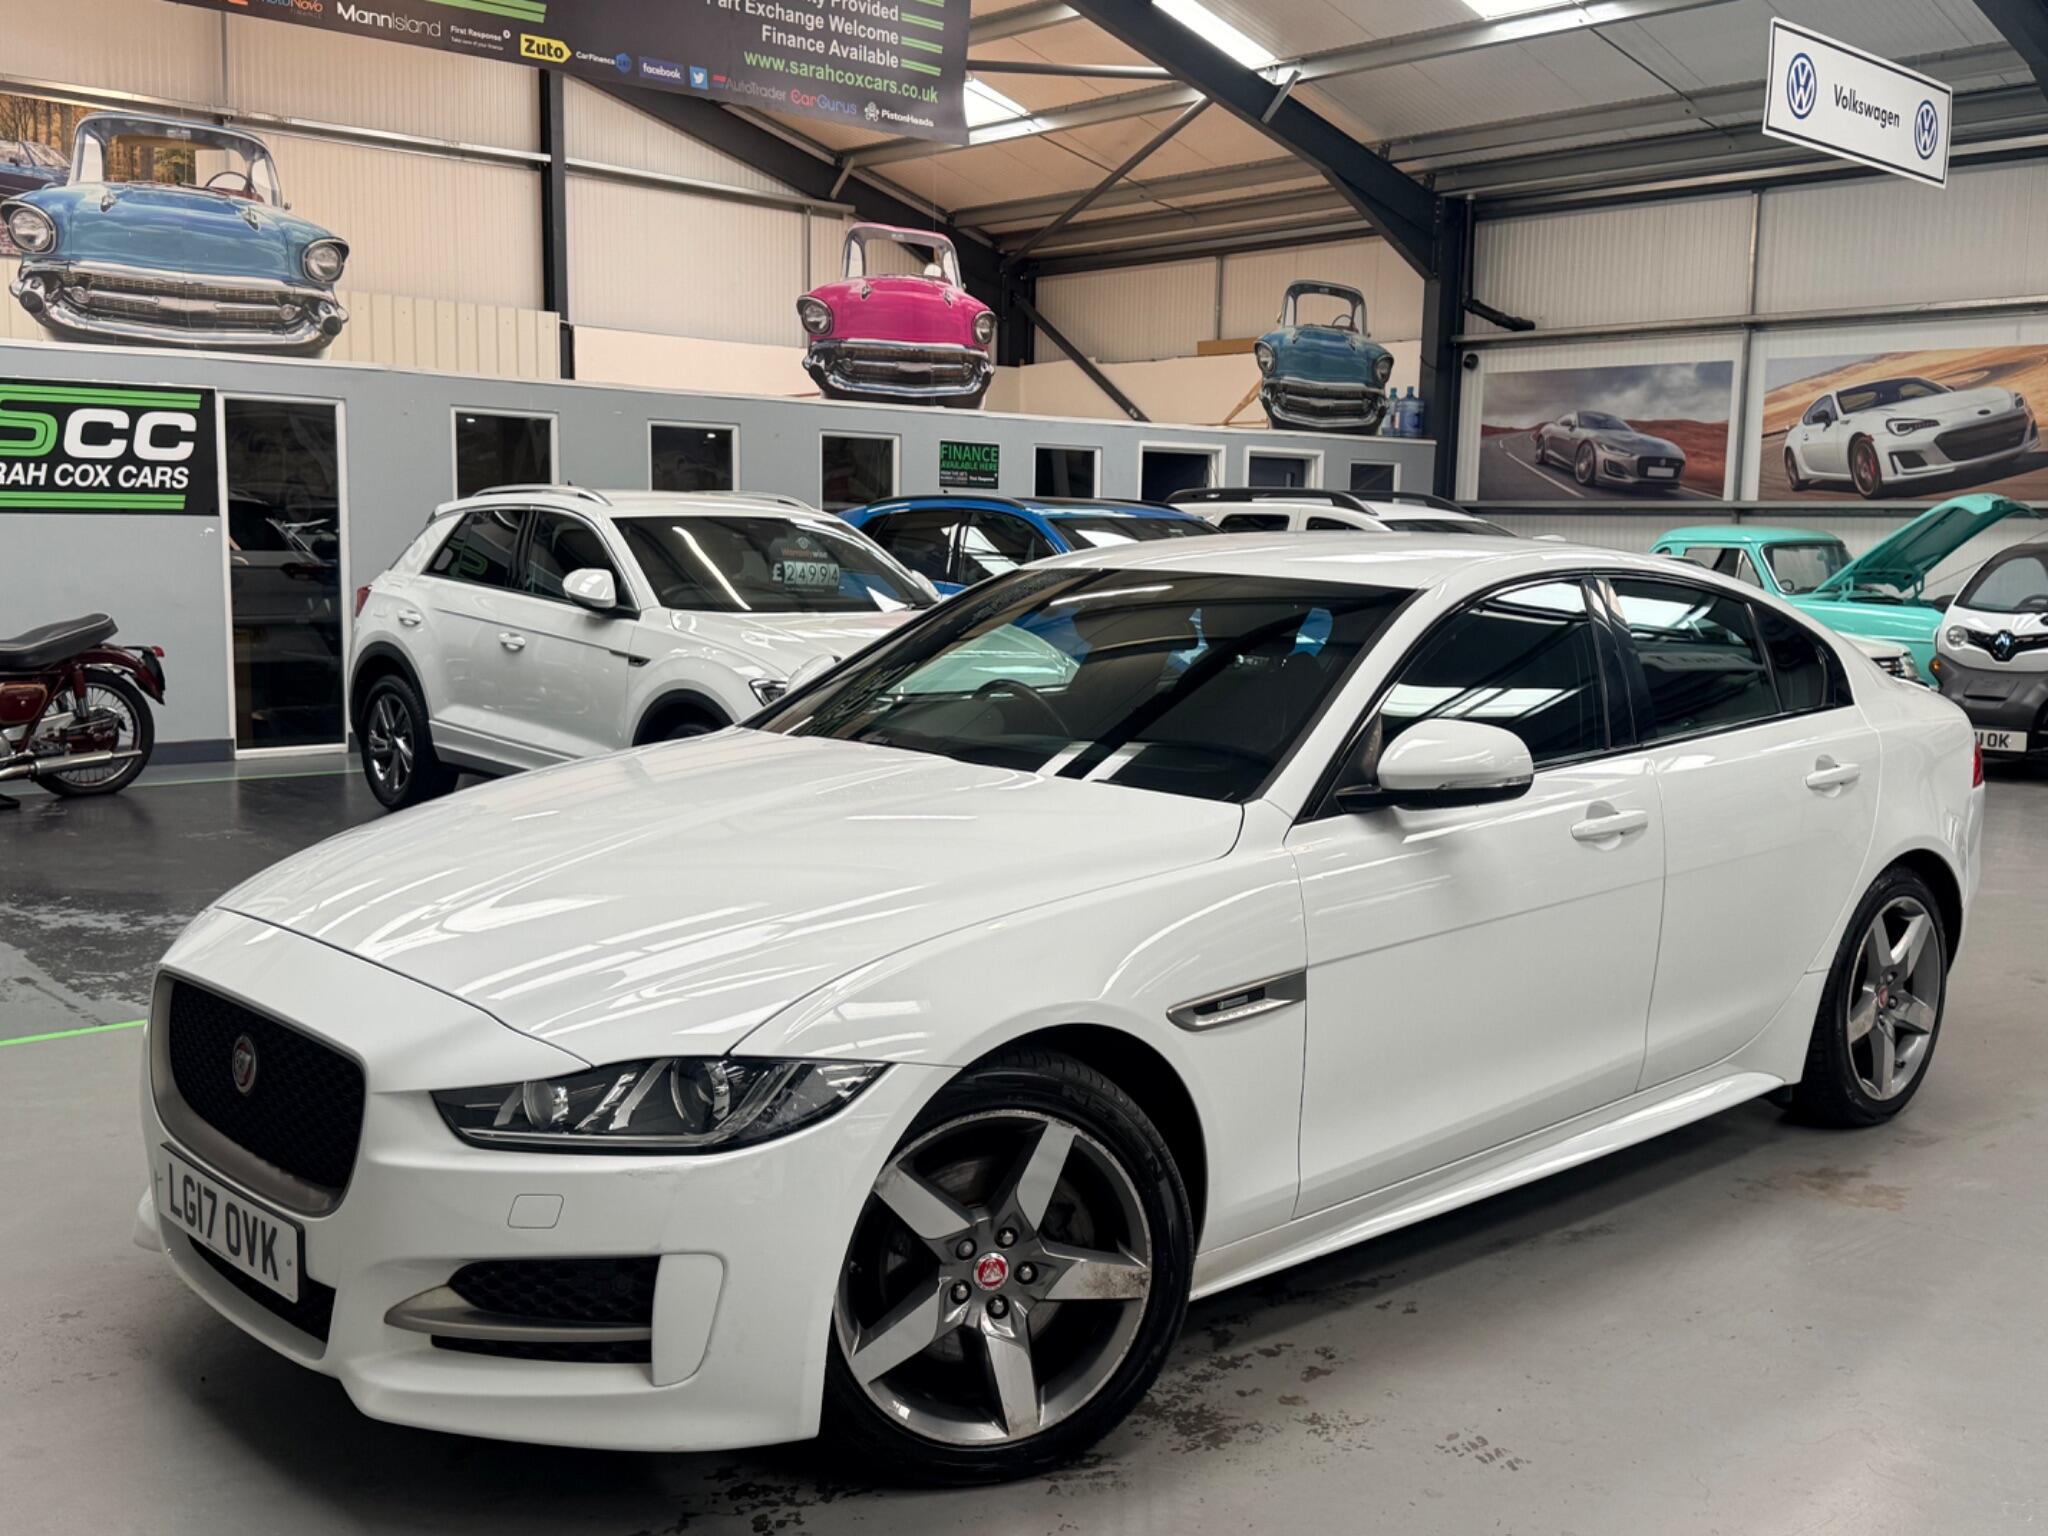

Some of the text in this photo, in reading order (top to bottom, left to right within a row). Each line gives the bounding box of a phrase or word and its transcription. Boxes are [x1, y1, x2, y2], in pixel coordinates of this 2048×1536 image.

[745, 0, 825, 31] Exchange
[828, 14, 899, 45] Welcome
[524, 38, 565, 59] Zuto
[761, 24, 899, 69] Finance Available
[642, 62, 682, 79] facebook
[743, 51, 939, 104] www.sarahcoxcars.co.uk
[791, 88, 857, 115] CarGurus
[1834, 84, 1901, 129] Volkswagen
[881, 109, 935, 127] PistonHeads
[940, 444, 998, 462] FINANCE
[941, 460, 998, 472] AVAILABLE HERE
[54, 462, 114, 488] COX
[117, 465, 189, 489] CARS
[169, 1162, 279, 1282] LG17 OVK
